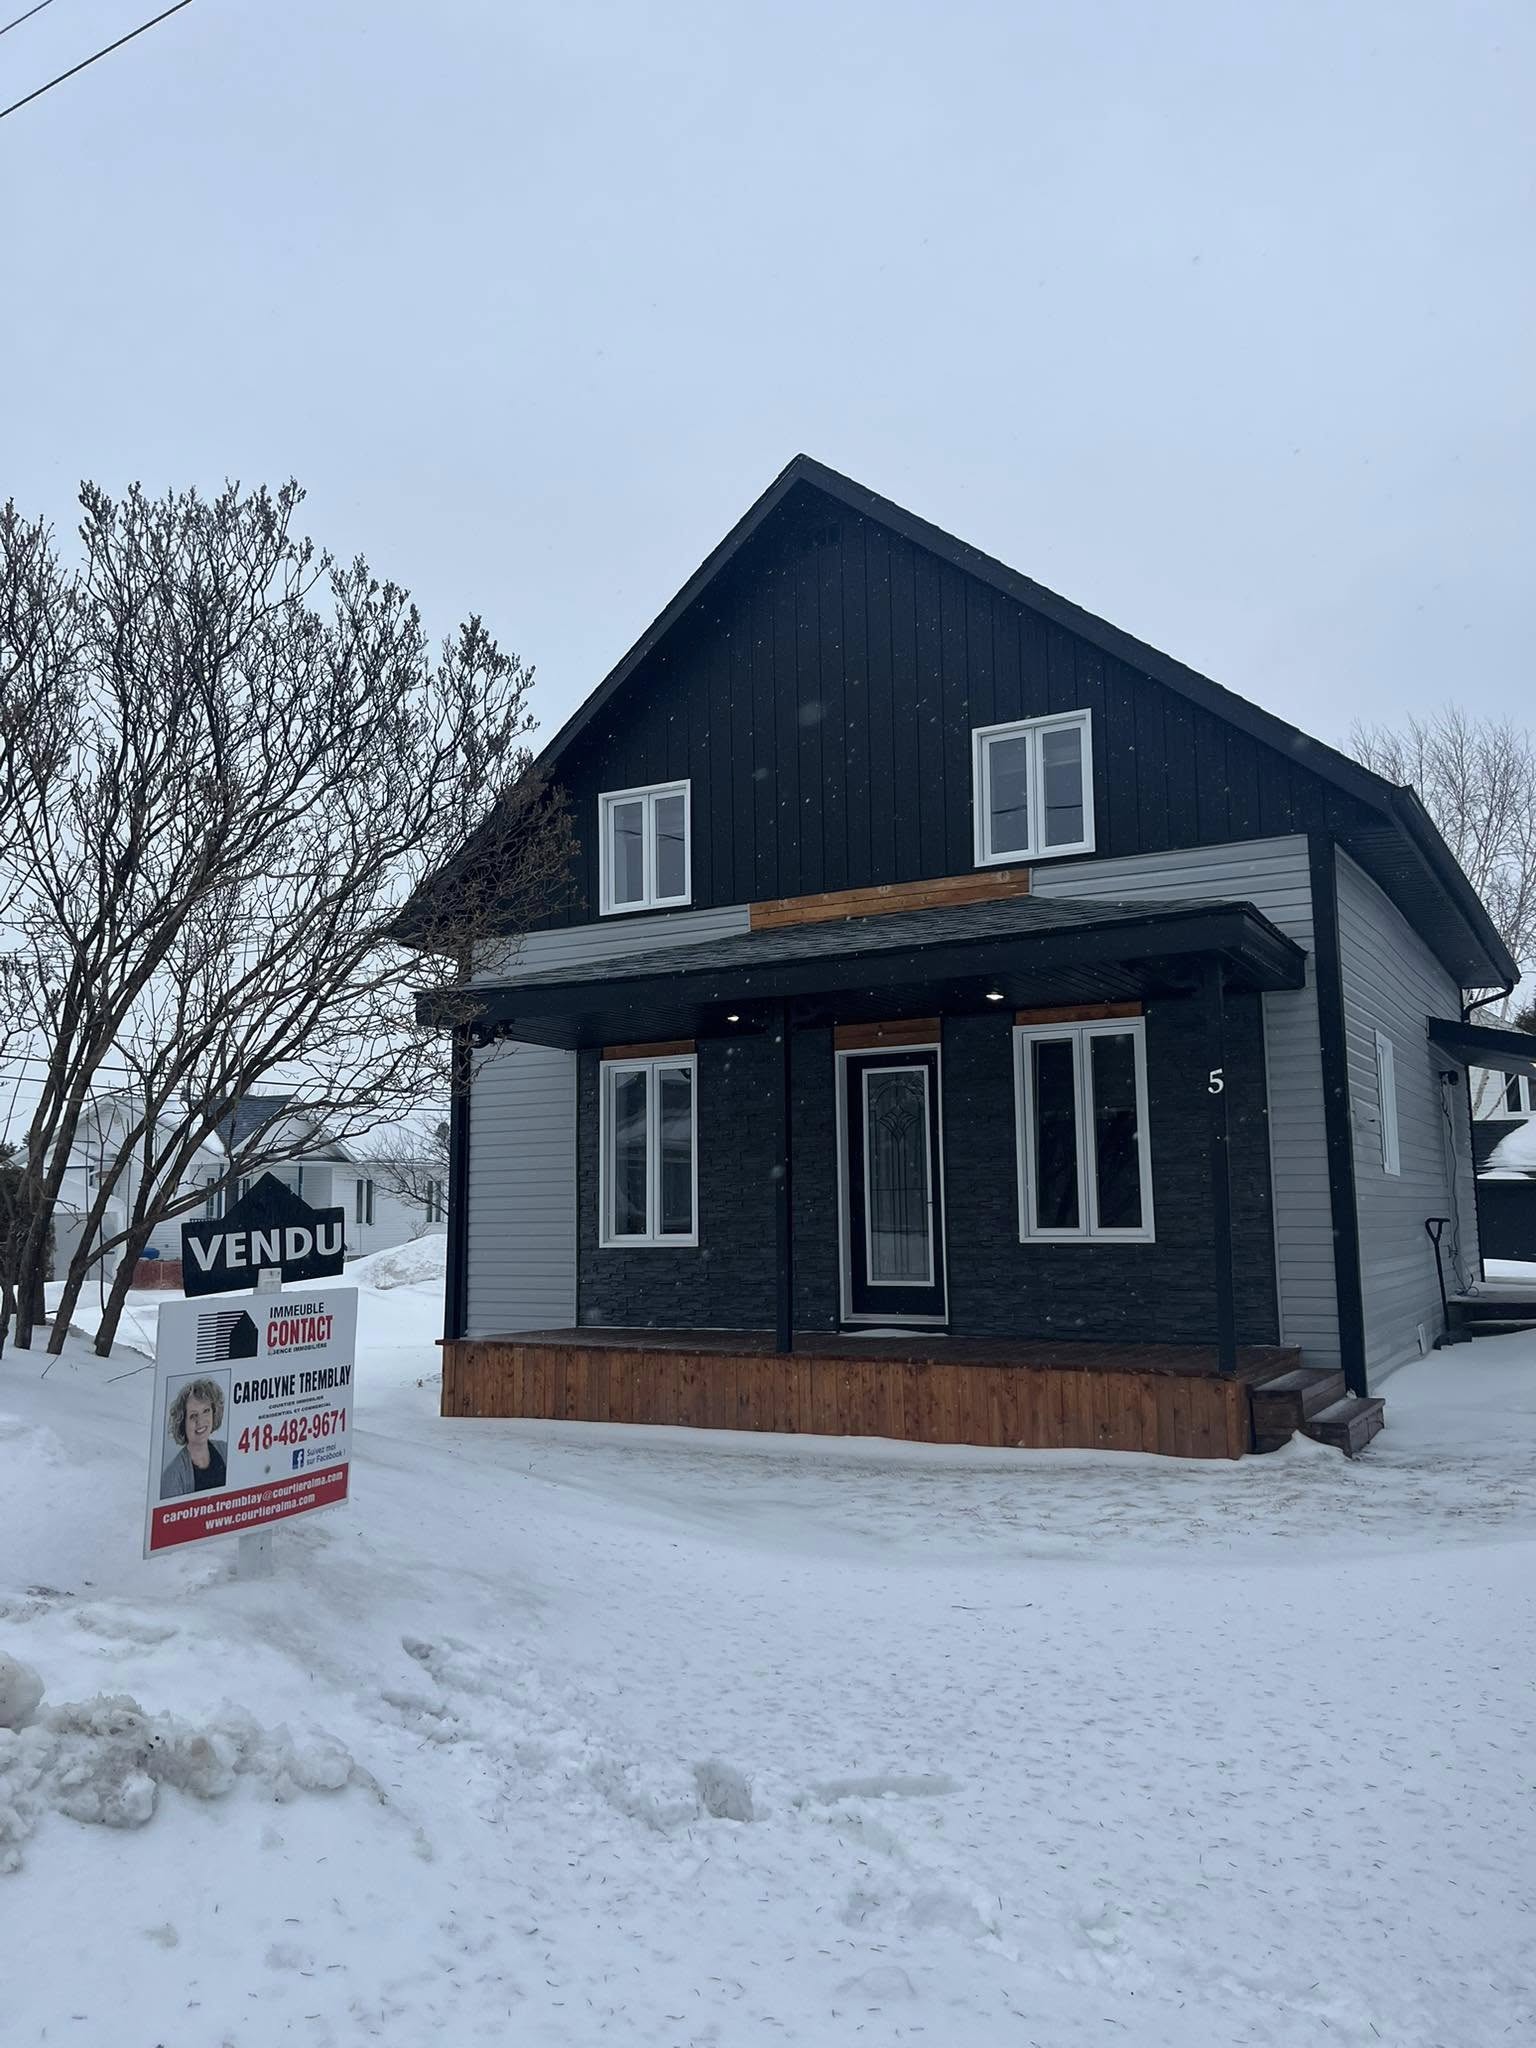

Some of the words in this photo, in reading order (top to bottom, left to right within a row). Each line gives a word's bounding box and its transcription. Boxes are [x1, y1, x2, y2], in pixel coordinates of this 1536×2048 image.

[1208, 1068, 1224, 1094] 5
[188, 1222, 343, 1271] VENDU
[269, 1302, 325, 1319] IMMEUBLE
[267, 1315, 333, 1348] CONTACT
[233, 1374, 296, 1405] CAROLYNE
[299, 1364, 351, 1394] TREMBLAY
[238, 1407, 346, 1454] 418-482-9671
[306, 1447, 325, 1457] Suivez
[326, 1443, 337, 1453] moi
[306, 1457, 315, 1466] sur
[316, 1450, 342, 1463] Facebook
[205, 1493, 316, 1530] www.courtieralma.com
